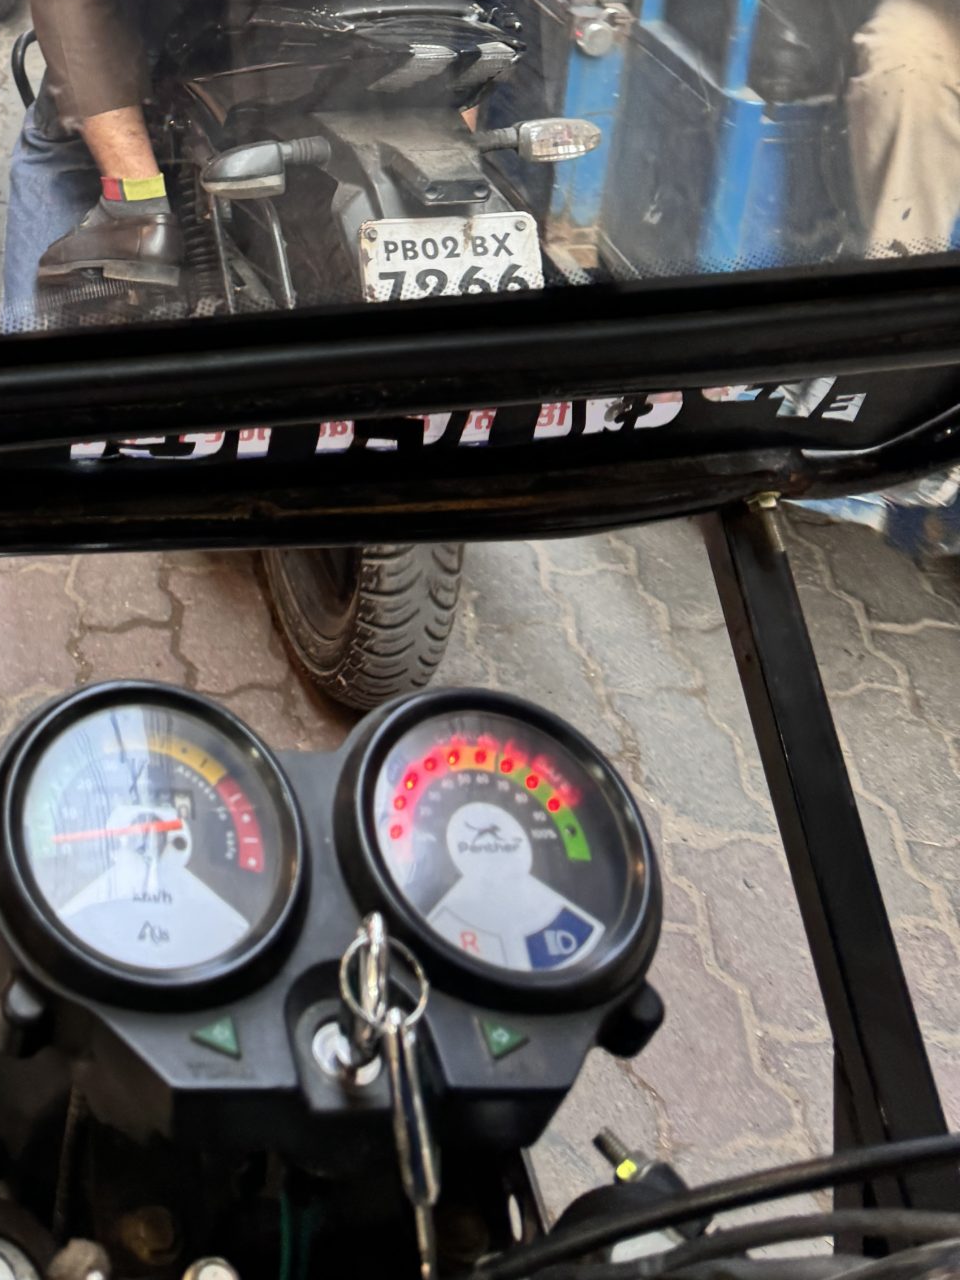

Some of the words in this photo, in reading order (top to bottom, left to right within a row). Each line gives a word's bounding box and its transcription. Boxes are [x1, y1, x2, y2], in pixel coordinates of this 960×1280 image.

[383, 236, 461, 262] PB02
[470, 231, 515, 258] BX
[459, 929, 481, 955] R
